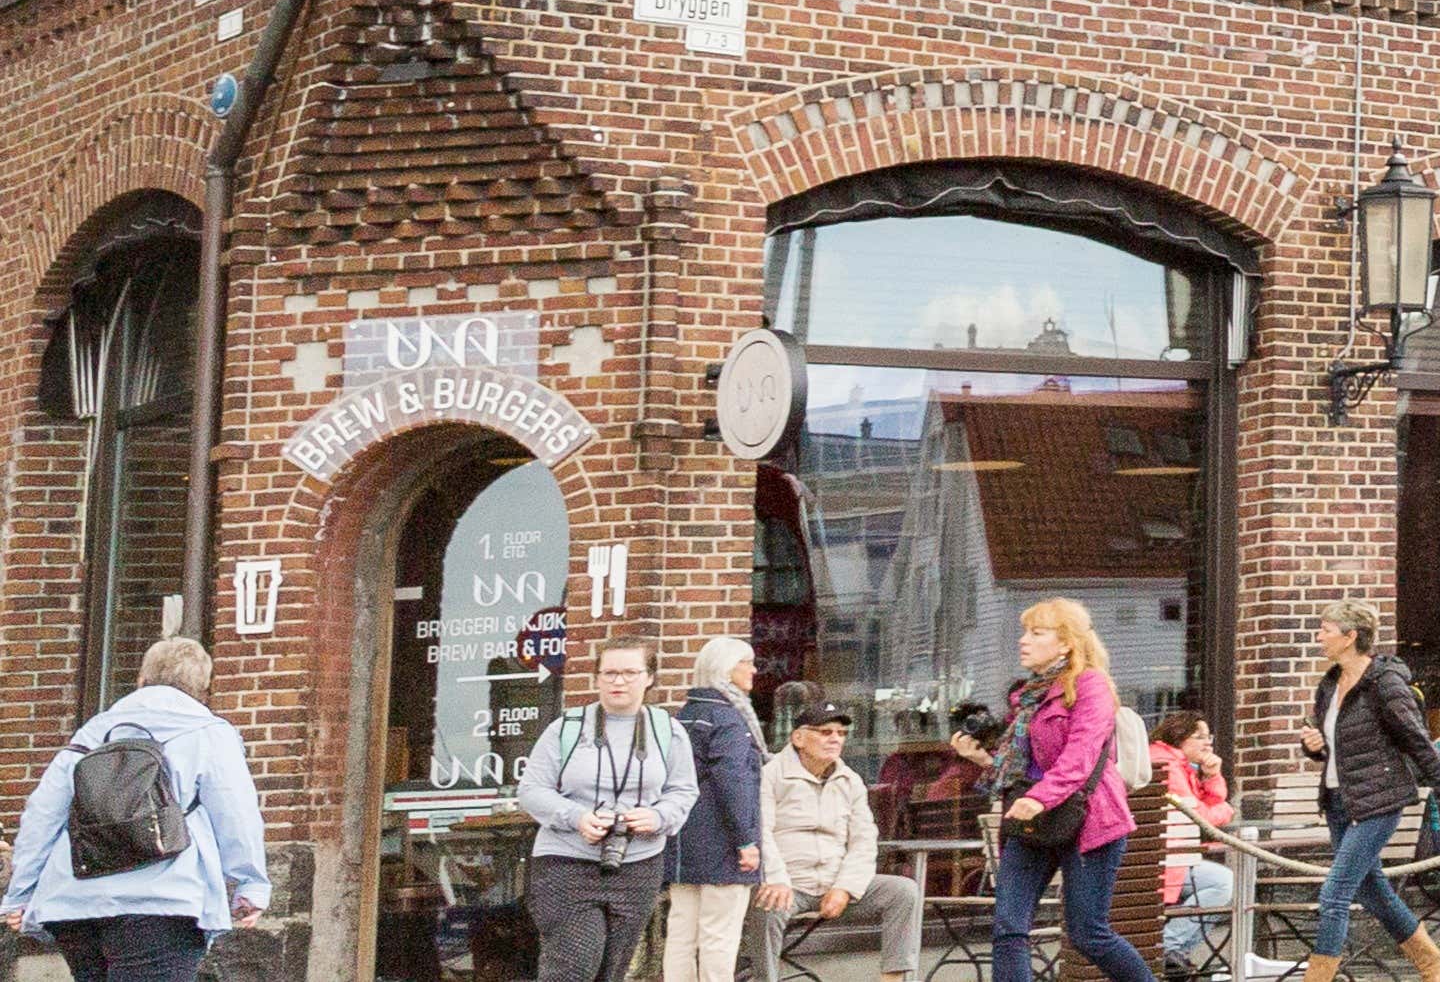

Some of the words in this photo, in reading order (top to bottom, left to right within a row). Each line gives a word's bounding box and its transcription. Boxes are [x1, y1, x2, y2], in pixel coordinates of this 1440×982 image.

[293, 392, 387, 470] BREW
[399, 382, 424, 415] &
[434, 378, 580, 455] BURGERS
[416, 617, 500, 639] BRYGGERI
[504, 616, 517, 633] &
[427, 643, 479, 664] BREW
[483, 640, 518, 659] BAR
[522, 639, 536, 657] &
